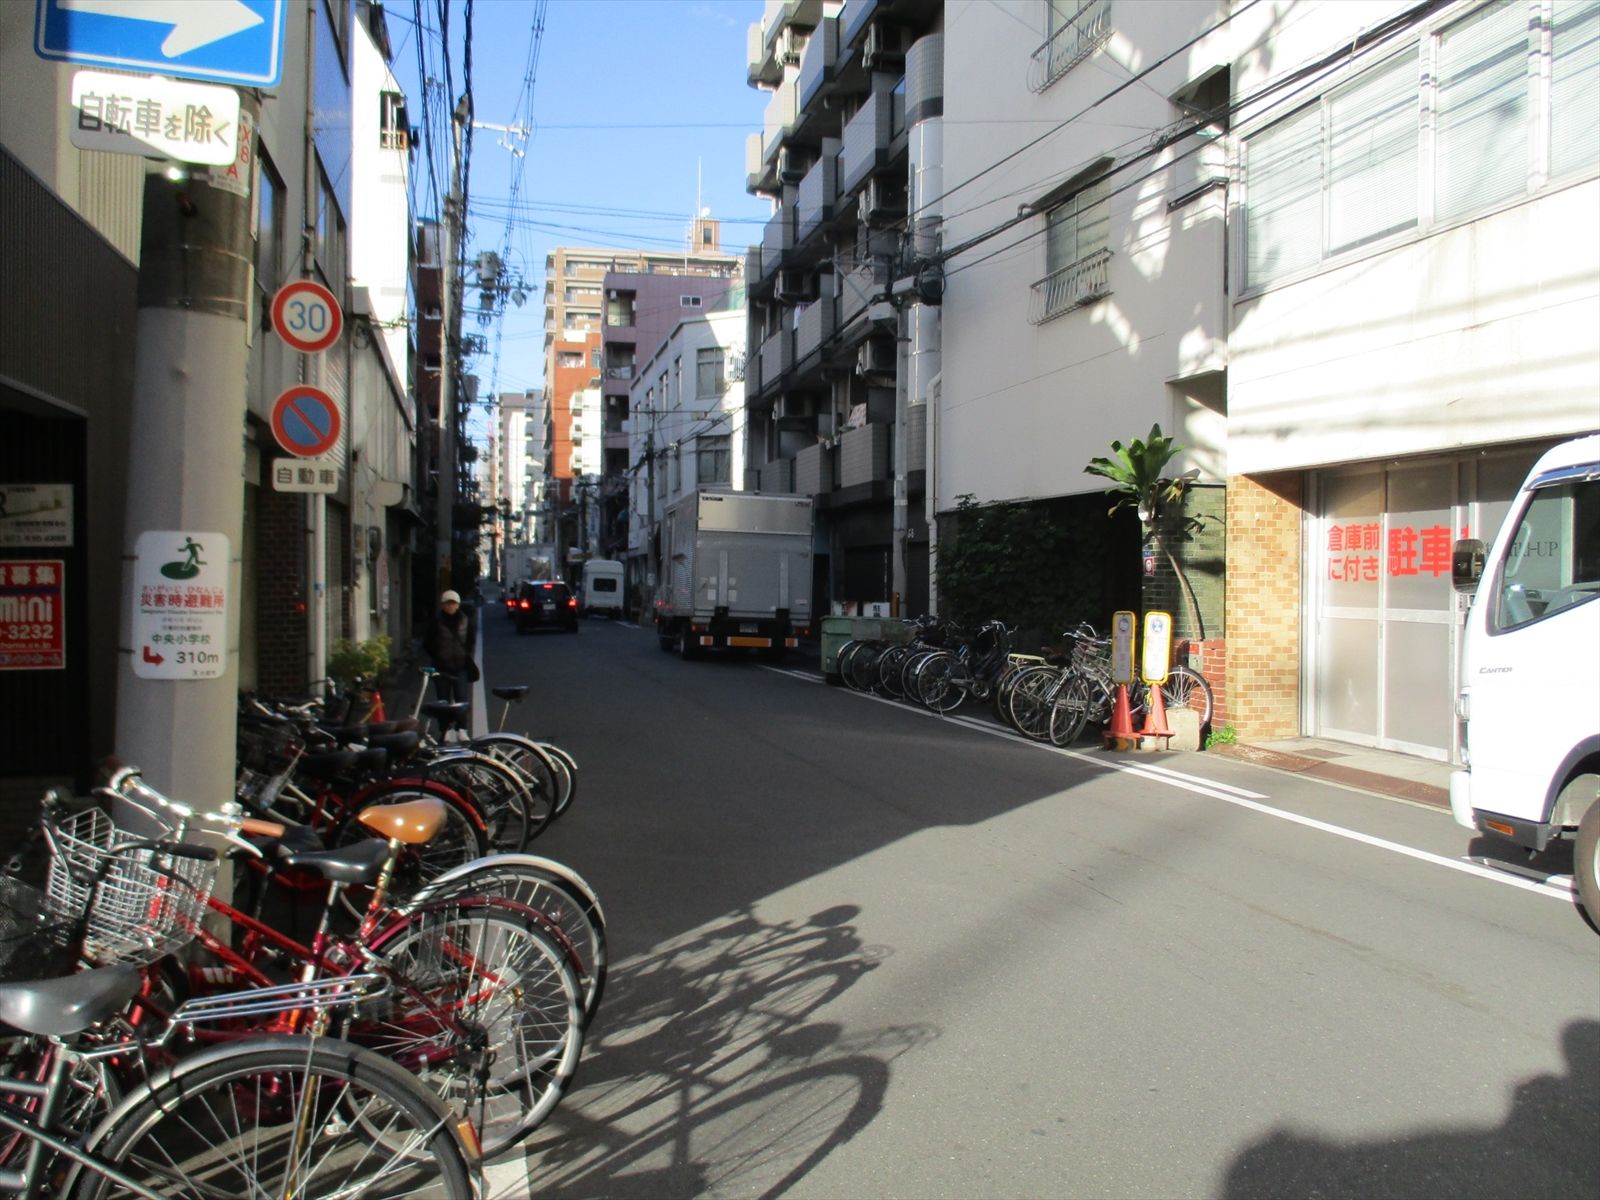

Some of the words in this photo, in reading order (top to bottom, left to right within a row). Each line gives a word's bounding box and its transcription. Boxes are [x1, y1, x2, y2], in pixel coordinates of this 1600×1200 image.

[78, 91, 231, 147] 自転車を除く
[288, 301, 326, 333] 30
[277, 467, 335, 485] 自動車
[1327, 523, 1380, 551] 倉庫前
[1387, 524, 1469, 577] 駐車
[1327, 555, 1380, 582] に付き
[141, 593, 225, 609] 災害時避難所
[0, 624, 54, 640] -3232
[152, 633, 211, 645] 中央小学校
[176, 651, 219, 664] 310m
[1479, 666, 1513, 675] CANTER
